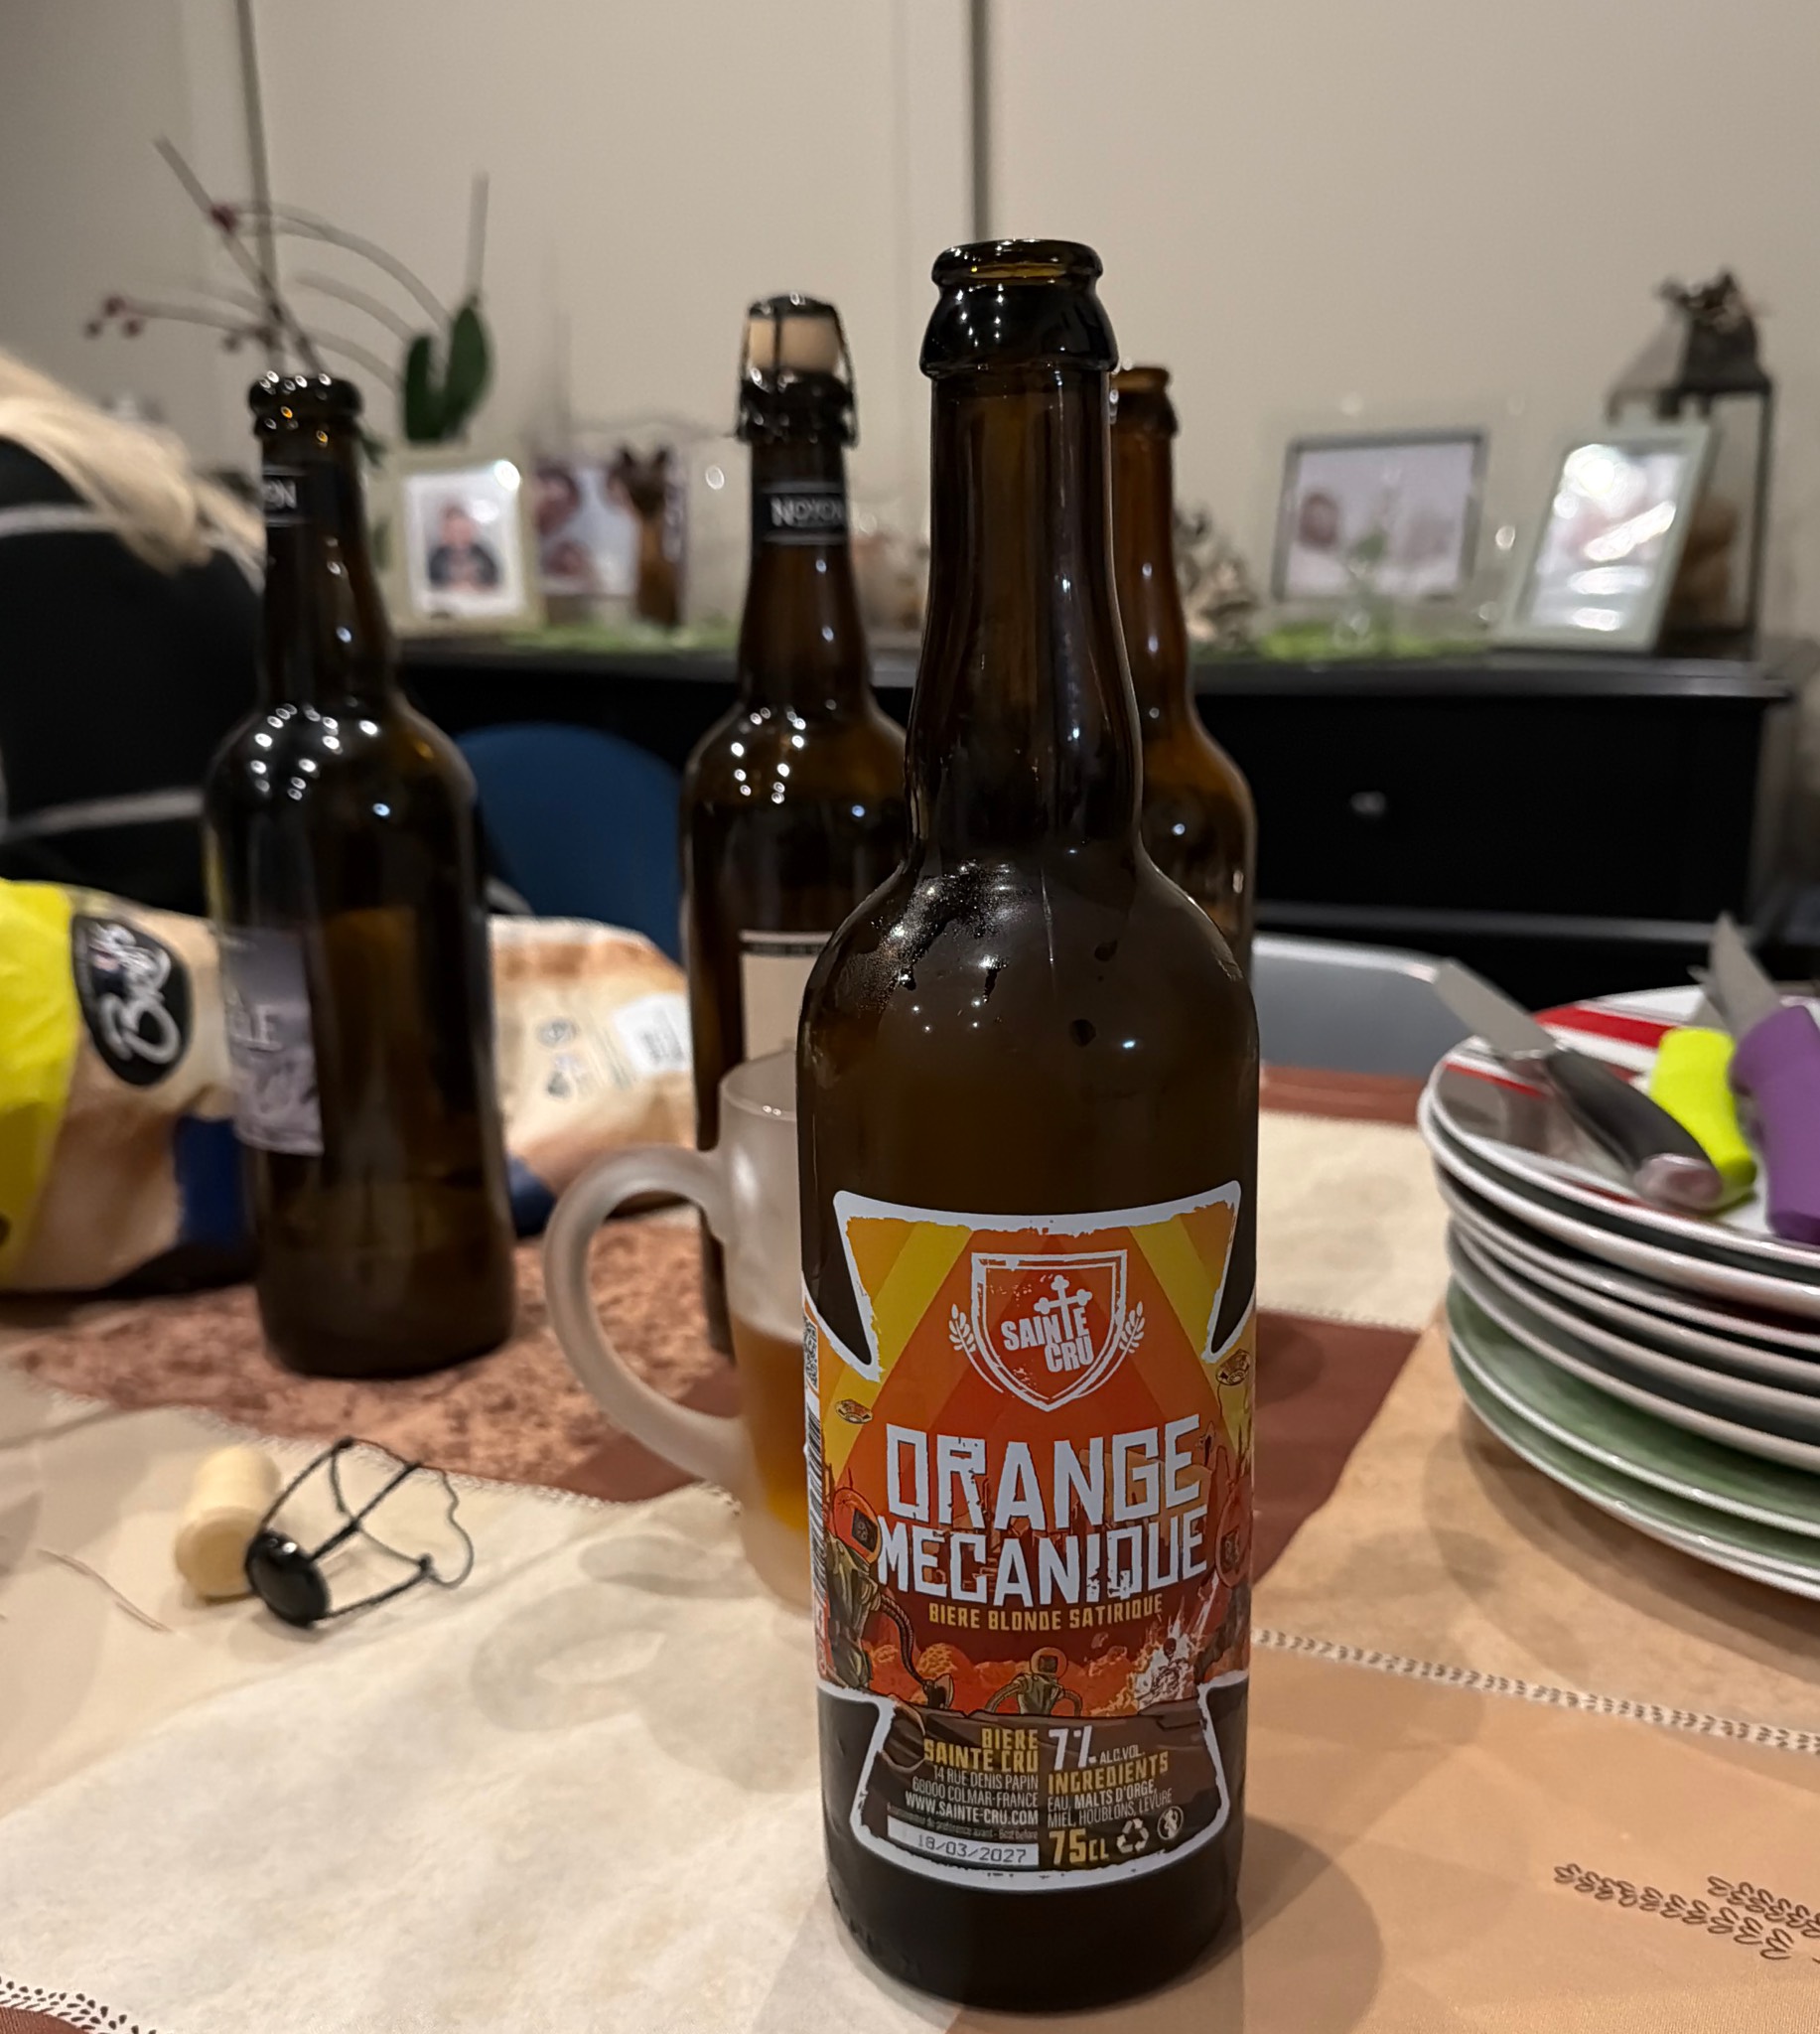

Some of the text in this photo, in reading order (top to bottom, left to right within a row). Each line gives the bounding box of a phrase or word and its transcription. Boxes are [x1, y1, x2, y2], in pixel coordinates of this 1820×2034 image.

[1001, 1295, 1090, 1351] SAINTE
[1045, 1336, 1094, 1373] CRU
[886, 1414, 1200, 1530] ORANGE
[877, 1504, 1208, 1608] MECANIQUE
[928, 1592, 1163, 1631] BIERE BLONDE SATIRIQUE
[923, 1738, 1039, 1773] SAINTE CRU
[982, 1727, 1039, 1750] BIERE
[911, 1776, 946, 1799] 68000
[933, 1765, 1039, 1791] 14 RUE DENIS PAPIN
[1048, 1751, 1170, 1795] INGREDIENTS
[905, 1791, 1039, 1825] WWW.SAINTE-CRU.COM
[1073, 1791, 1113, 1810] MALTS
[1139, 1788, 1173, 1814] LEVURE
[917, 1834, 1027, 1863] 18/03/2027
